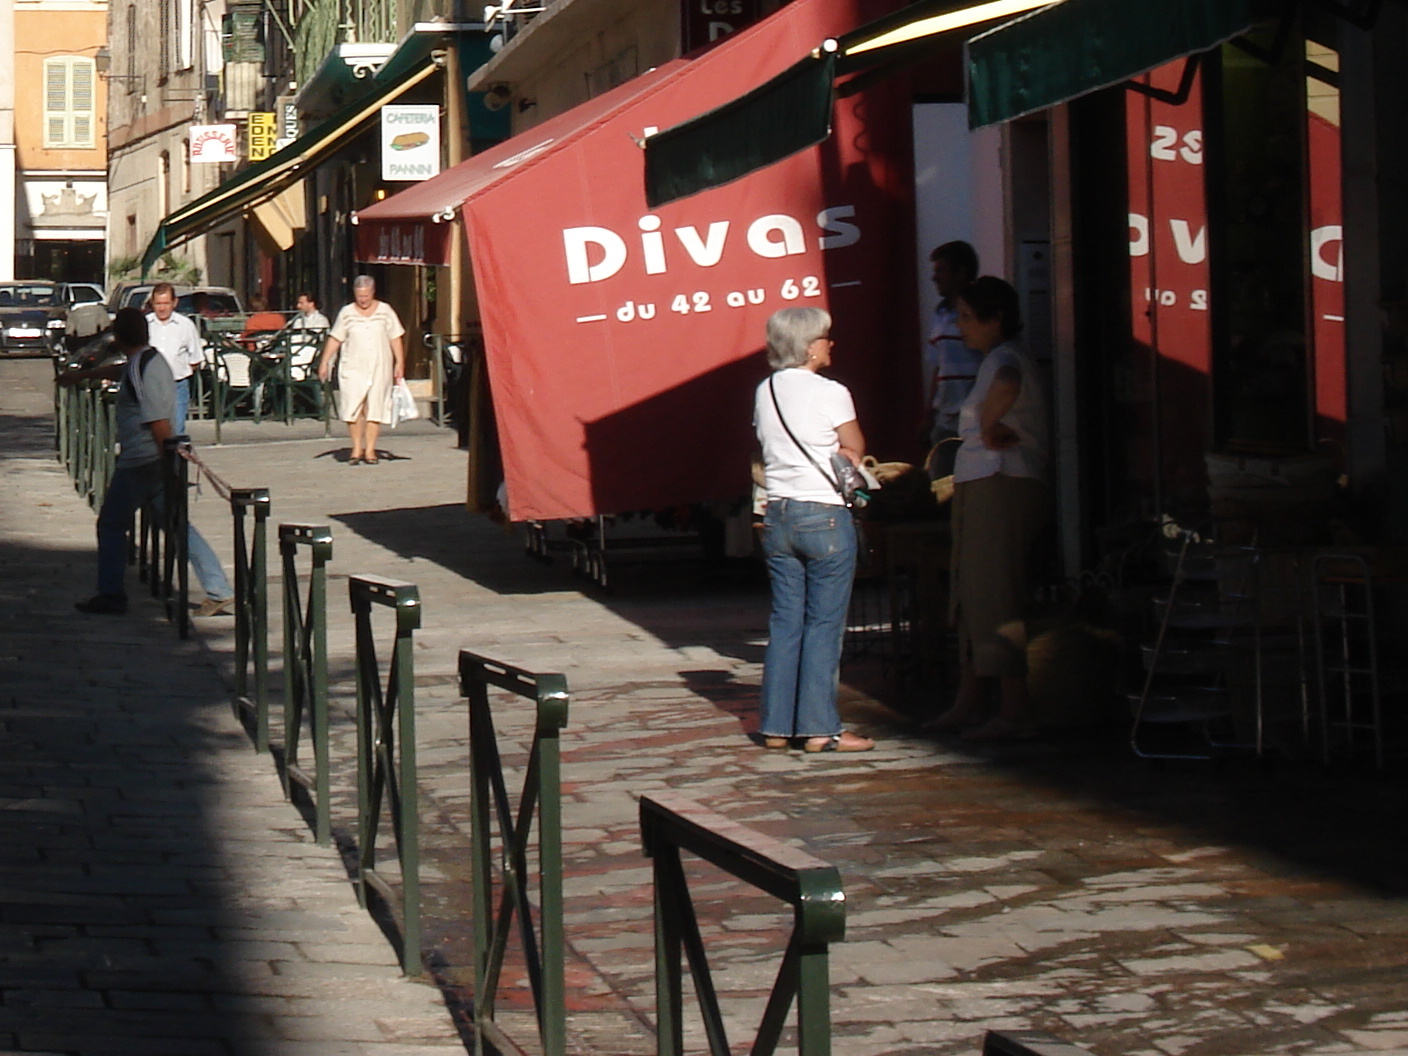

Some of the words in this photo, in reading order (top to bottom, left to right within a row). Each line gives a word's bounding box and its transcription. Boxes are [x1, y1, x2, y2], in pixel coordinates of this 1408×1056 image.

[251, 114, 264, 157] EDEN
[285, 105, 299, 138] QUES
[562, 205, 862, 285] Divas
[616, 301, 656, 322] du
[671, 291, 712, 315] 42
[726, 288, 765, 308] au
[781, 276, 821, 300] 62
